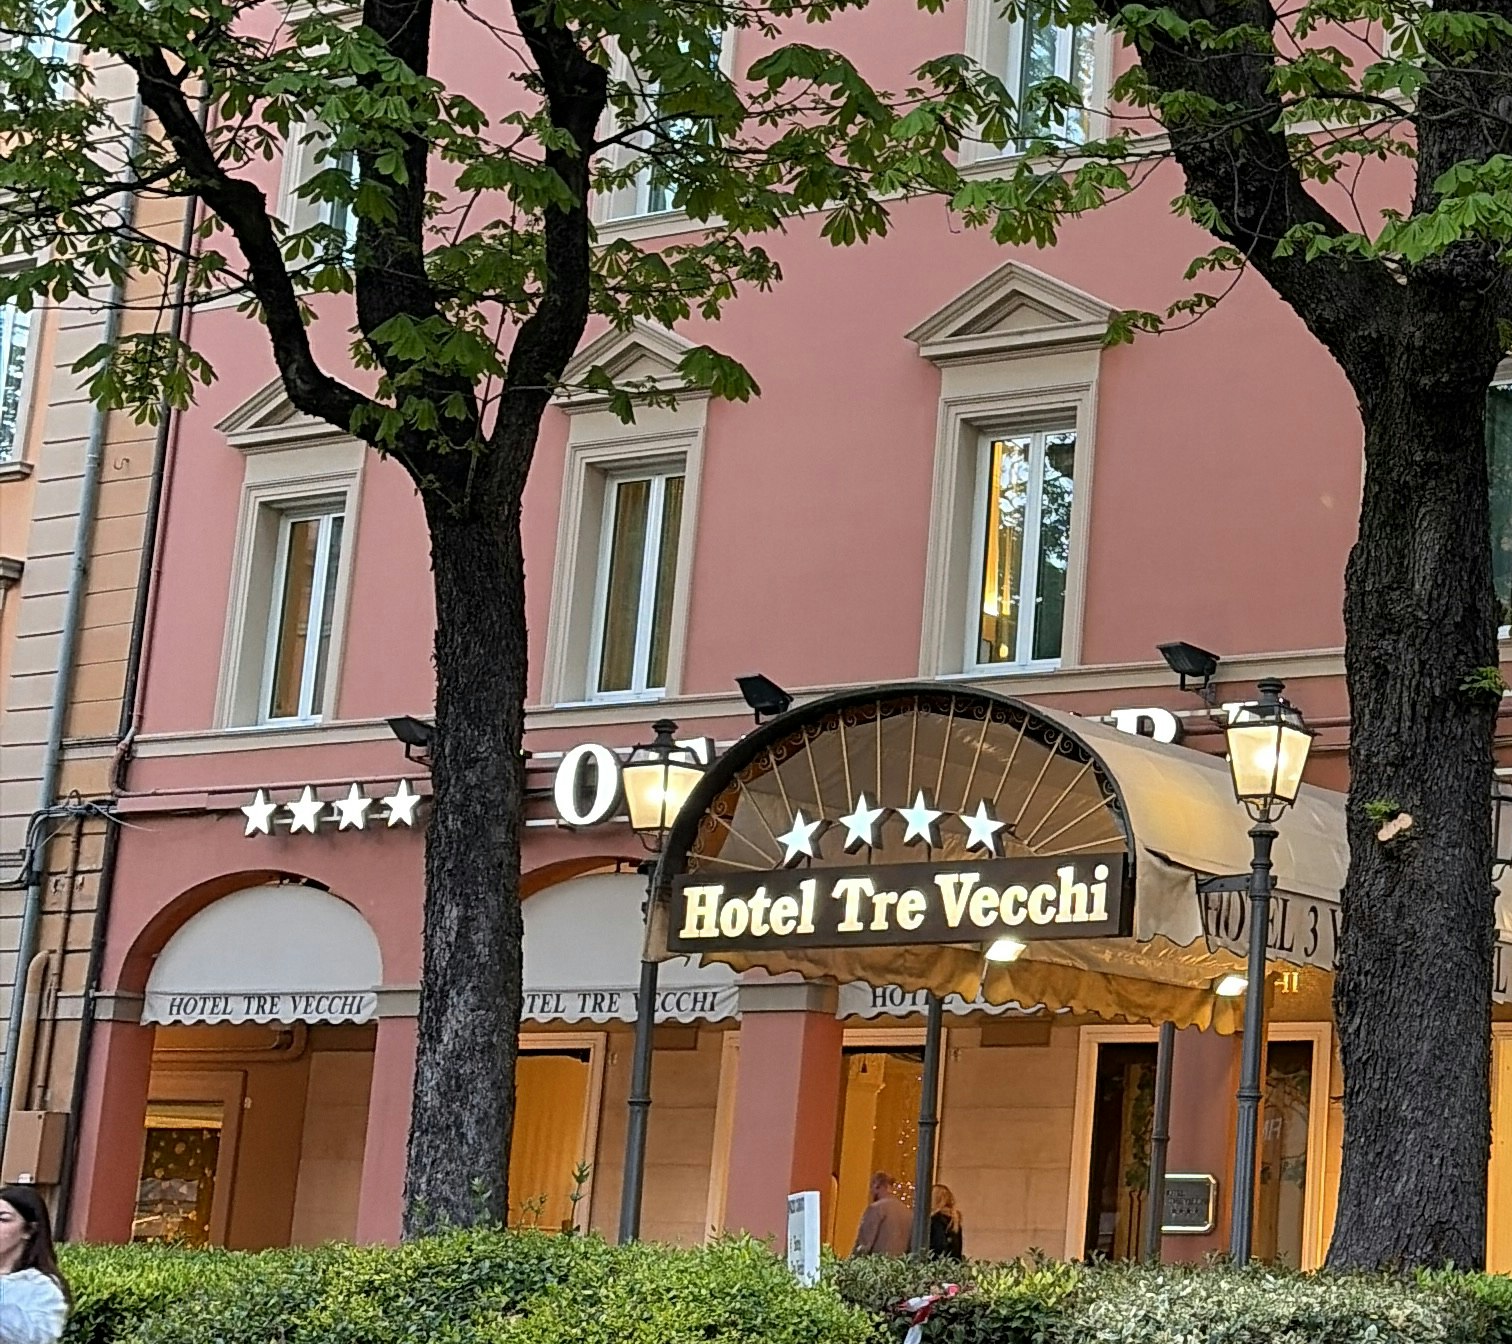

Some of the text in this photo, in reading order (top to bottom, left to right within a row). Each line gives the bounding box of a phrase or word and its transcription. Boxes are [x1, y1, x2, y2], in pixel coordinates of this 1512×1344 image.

[679, 863, 1109, 939] Hotel Tre Vecchi
[1303, 905, 1319, 957] 3
[168, 994, 366, 1016] HOTEL TRE VECCHI
[522, 993, 567, 1014] TEL
[577, 992, 622, 1014] TRE
